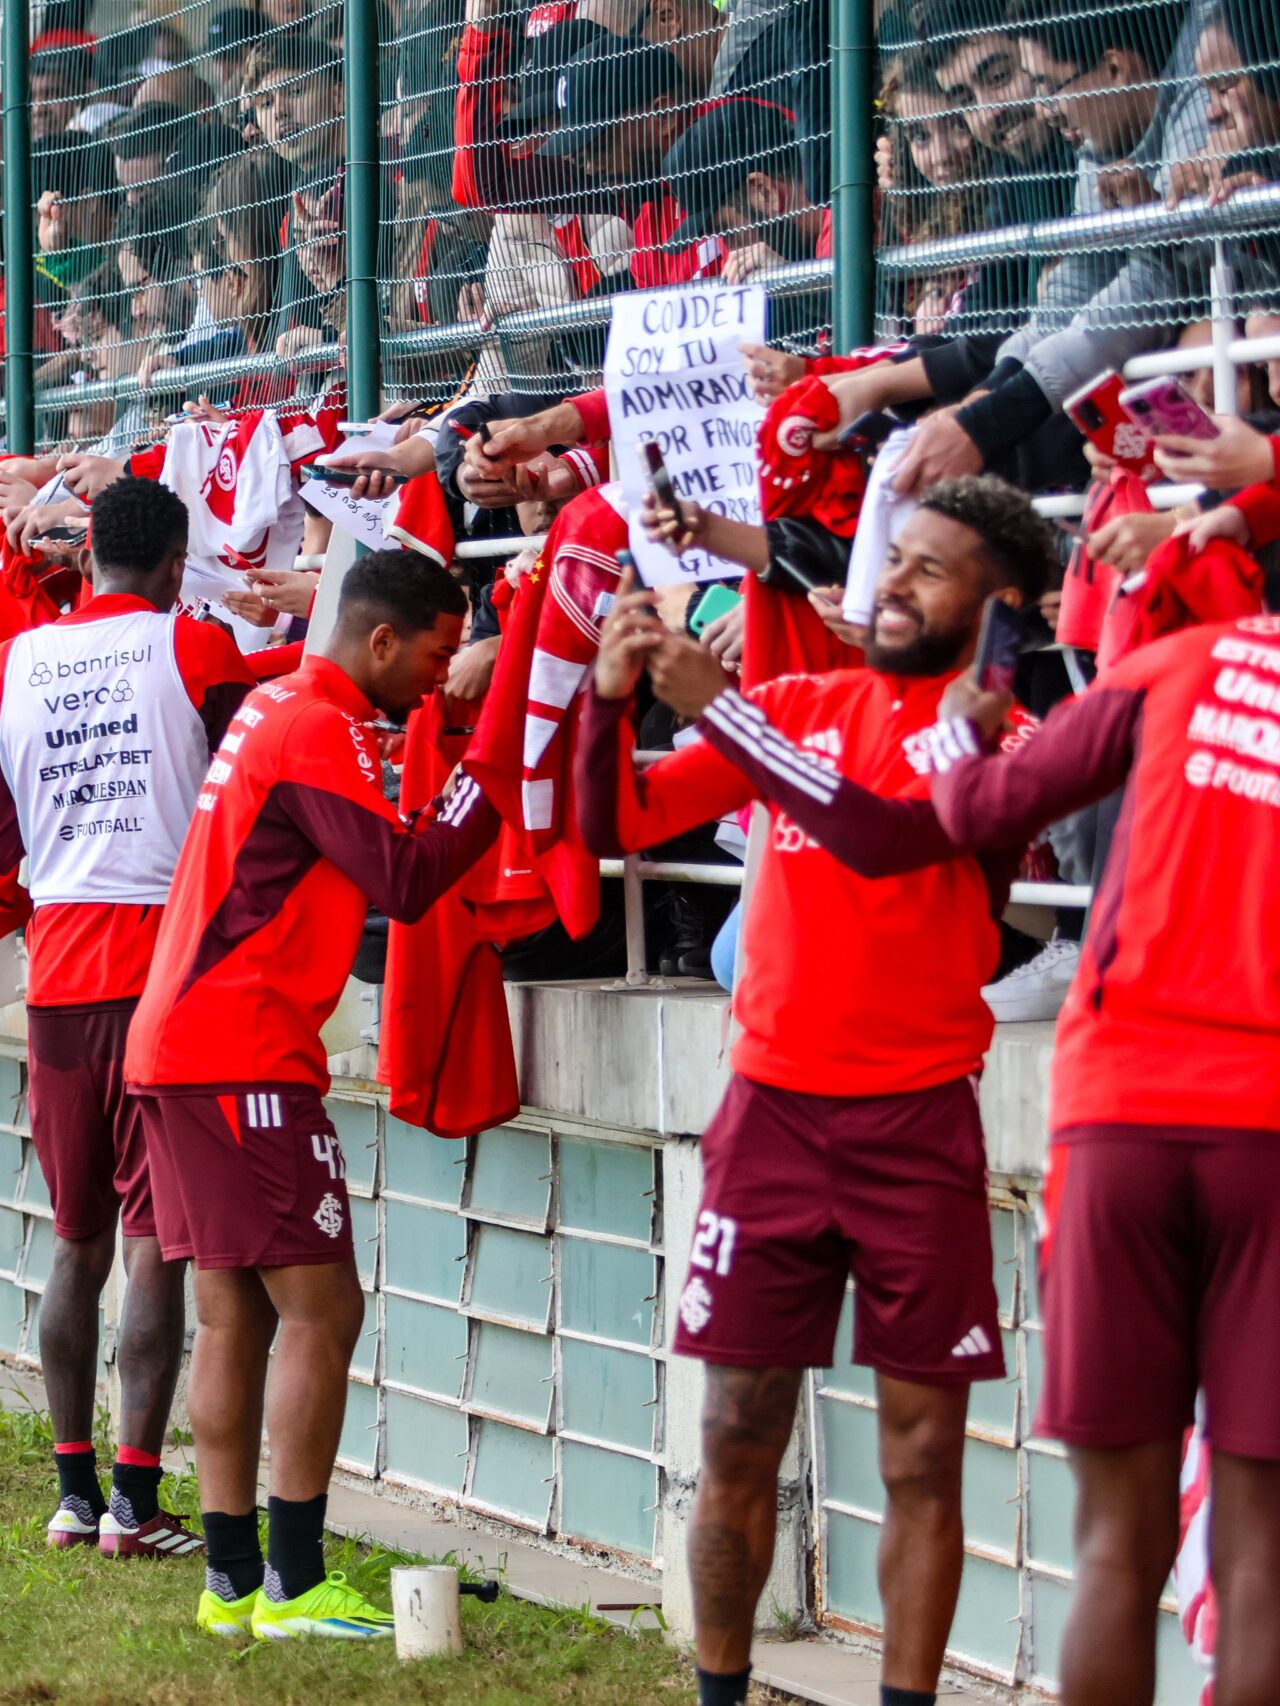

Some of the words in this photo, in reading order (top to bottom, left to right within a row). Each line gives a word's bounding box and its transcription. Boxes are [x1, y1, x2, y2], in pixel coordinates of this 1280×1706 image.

[642, 288, 752, 335] COUDET
[620, 346, 664, 377] SOY
[678, 337, 717, 368] TU
[671, 464, 725, 497] AME
[729, 462, 754, 487] TU
[57, 645, 152, 679] banrisul
[44, 687, 110, 714] vero
[46, 714, 138, 749] Unimed
[311, 1134, 345, 1180] 47
[690, 1210, 736, 1276] 21
